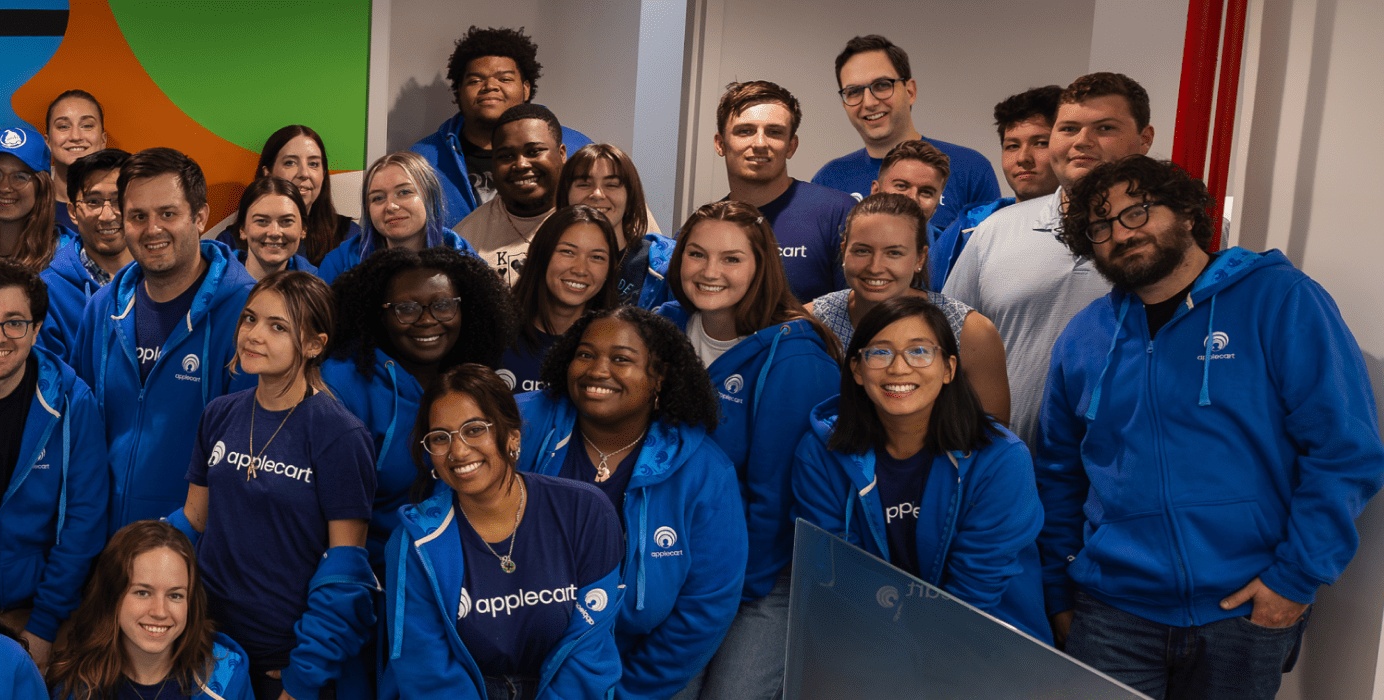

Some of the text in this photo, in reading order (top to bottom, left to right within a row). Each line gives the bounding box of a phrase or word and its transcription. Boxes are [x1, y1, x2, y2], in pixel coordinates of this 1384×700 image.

[496, 252, 507, 266] K
[651, 550, 683, 559] applecart
[475, 583, 578, 618] applecart
